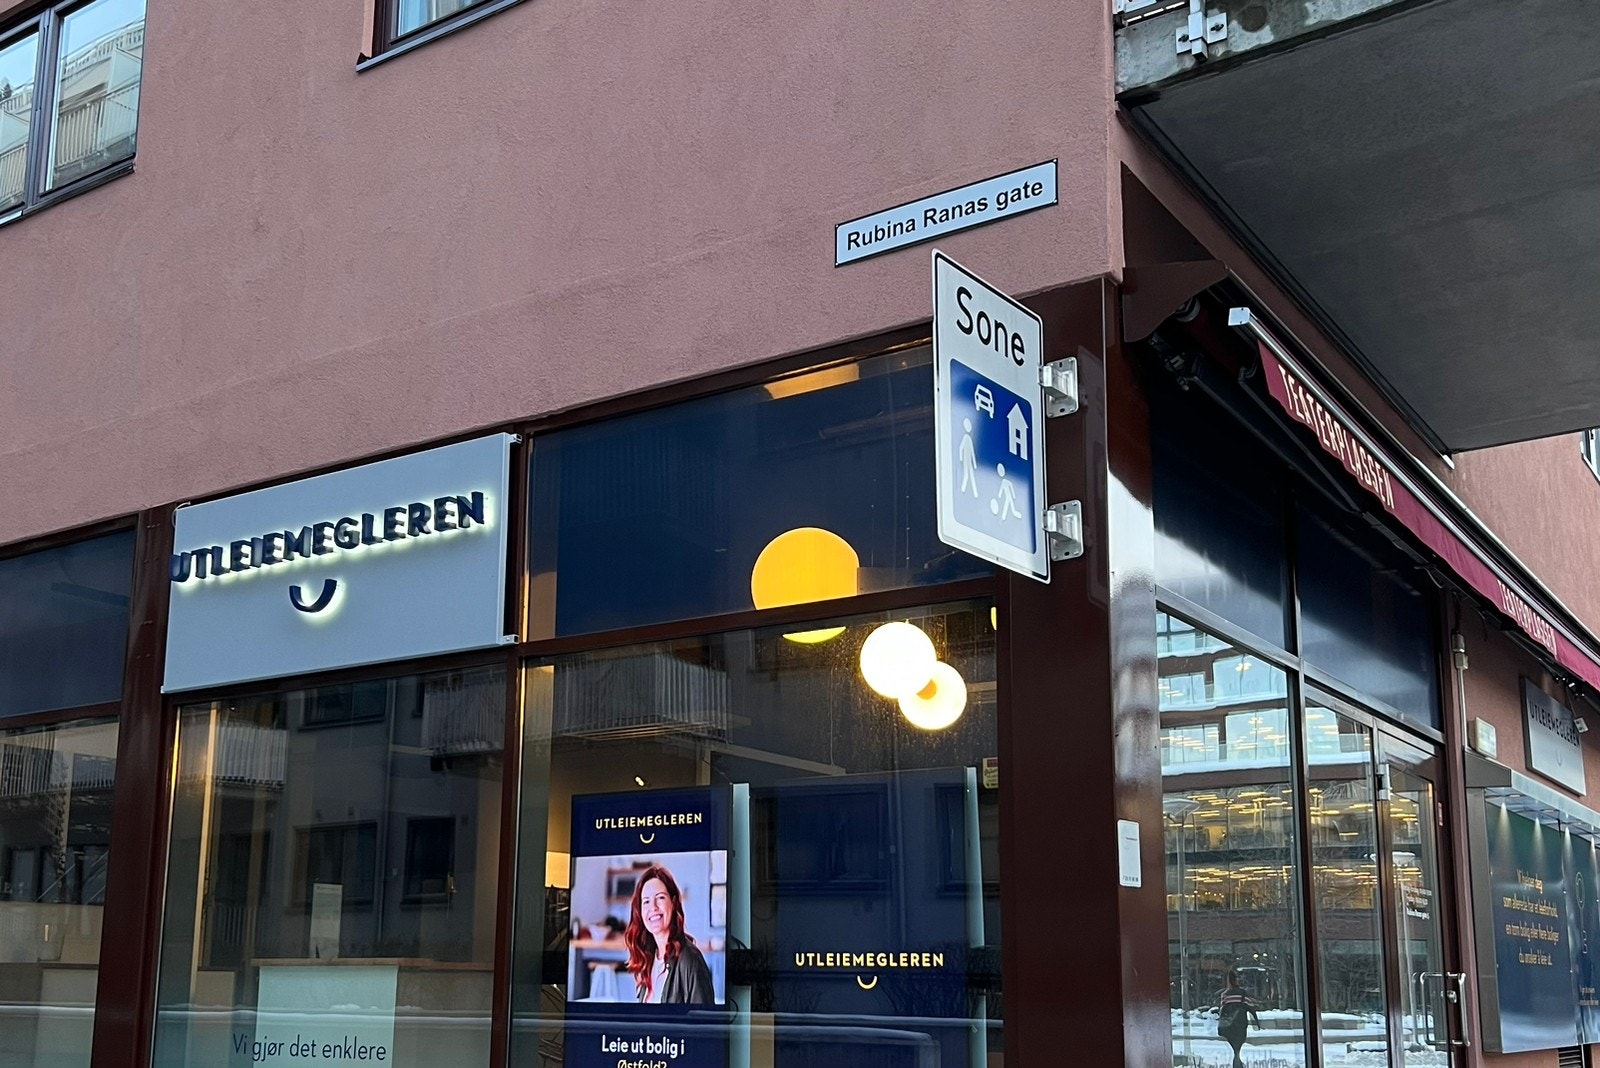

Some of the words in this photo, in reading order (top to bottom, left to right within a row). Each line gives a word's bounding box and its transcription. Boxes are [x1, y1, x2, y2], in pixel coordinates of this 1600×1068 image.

[847, 218, 916, 250] Rubina
[923, 196, 988, 228] Ranas
[996, 181, 1043, 212] gate
[956, 286, 1025, 367] Sone
[1278, 364, 1395, 509] TEATERPLASSEN
[169, 491, 485, 582] UTLEIEMEGLEREN
[1529, 700, 1580, 747] UTLEIEMEGLEREN
[595, 813, 702, 829] UTLEIEMEGLEREN
[795, 952, 944, 967] UTLEIEMEGLEREN
[233, 1033, 247, 1054] Vi
[252, 1035, 284, 1062] gjør
[290, 1034, 317, 1058] det
[322, 1035, 386, 1061] enklere
[601, 1034, 629, 1053] Leie
[631, 1038, 644, 1054] ut
[646, 1035, 678, 1059] bolig
[680, 1038, 685, 1055] i
